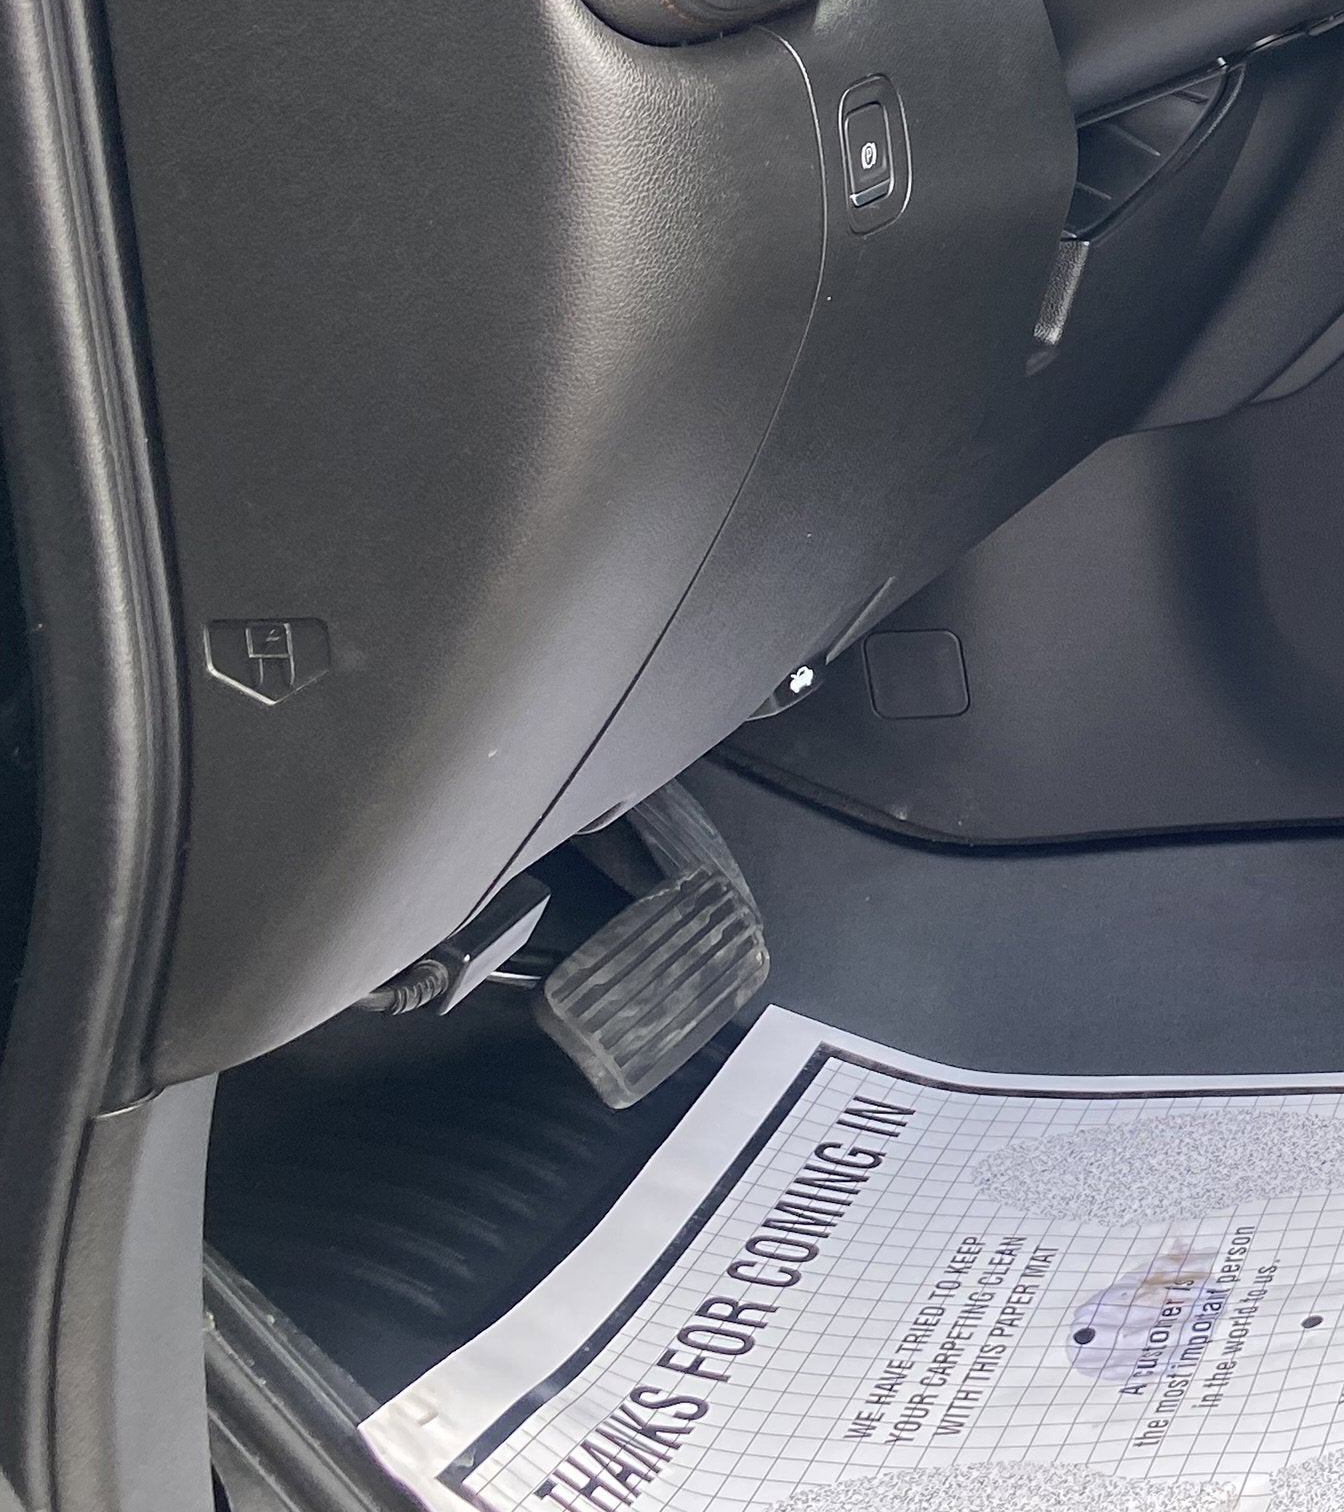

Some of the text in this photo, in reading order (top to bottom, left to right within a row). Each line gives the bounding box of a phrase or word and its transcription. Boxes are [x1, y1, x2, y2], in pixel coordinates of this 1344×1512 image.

[533, 1095, 917, 1512] THANKS FOR COMING IN
[843, 1236, 986, 1439] WE HAVE TRIED TO KEEP
[884, 1236, 1027, 1444] YOUR CARPETING CLEAN
[933, 1245, 1059, 1436] WITH THIS PAPER MAT
[1119, 1383, 1147, 1395] A
[1165, 1279, 1195, 1291] is
[1133, 1419, 1168, 1447] the
[1155, 1372, 1192, 1413] most
[1216, 1225, 1256, 1285] person
[1192, 1259, 1281, 1408] in the world to us.
